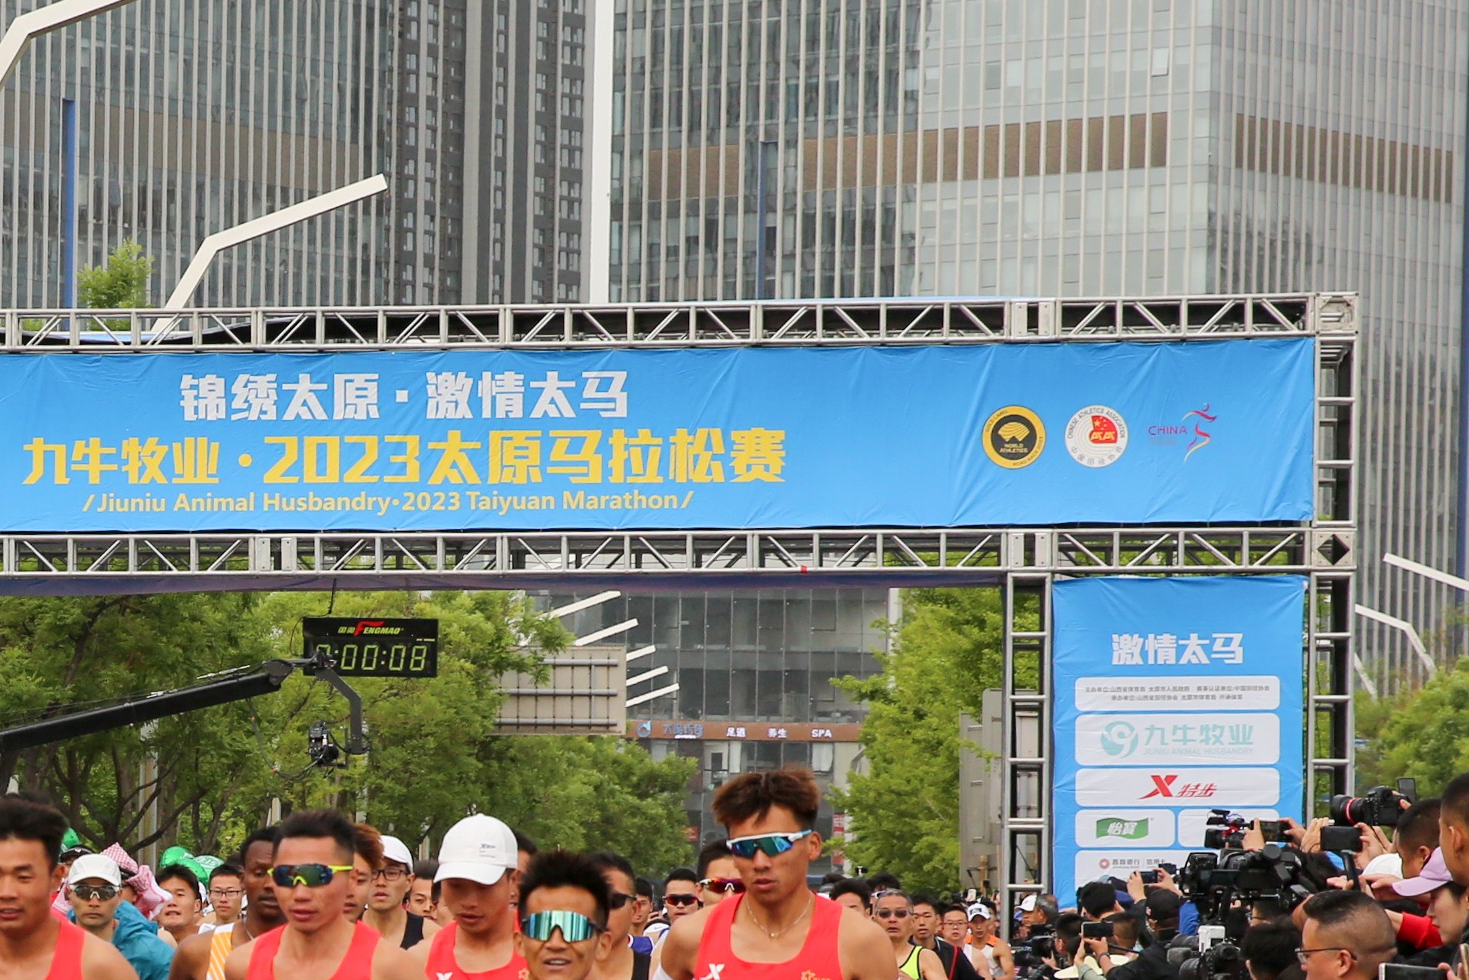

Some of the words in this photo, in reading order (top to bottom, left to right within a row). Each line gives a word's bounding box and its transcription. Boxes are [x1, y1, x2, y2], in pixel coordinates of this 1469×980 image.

[180, 371, 628, 421] 锦绣太原·激情太马
[21, 427, 786, 486] 九牛牧业·2023太原马拉松赛
[173, 493, 255, 513] Animal
[467, 490, 554, 516] Taiyuan
[1111, 633, 1244, 665] 激情太马
[811, 728, 833, 738] SPA
[1145, 723, 1254, 746] 九牛牧业
[1176, 783, 1218, 798] 特步
